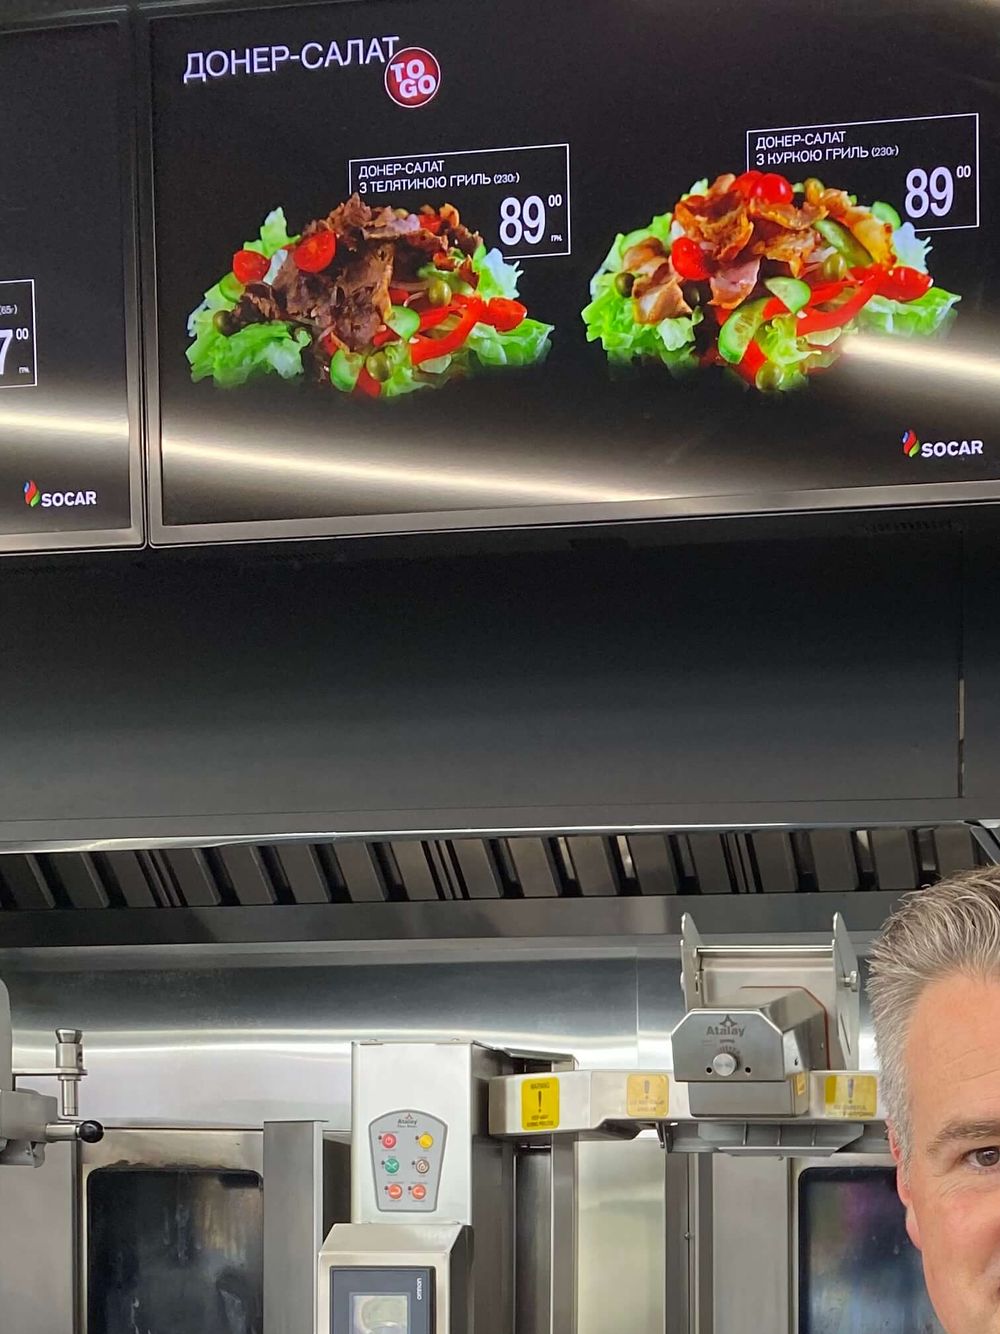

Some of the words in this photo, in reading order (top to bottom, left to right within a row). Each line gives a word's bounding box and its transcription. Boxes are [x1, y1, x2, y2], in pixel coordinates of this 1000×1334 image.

[183, 36, 400, 84] ДОНЕР-САЛАТ
[390, 59, 425, 83] TO
[400, 75, 436, 99] GO
[754, 131, 847, 150] ДОНЕР-САЛАТ
[767, 148, 822, 164] КУРКОЮ
[825, 146, 869, 160] ГРИЛЬ
[358, 160, 444, 179] ДОНЕР-САЛАТ
[956, 165, 971, 178] 00
[370, 176, 447, 193] ТЕЛЯТИНОЮ
[450, 173, 491, 187] ГРИЛЬ
[904, 166, 954, 218] 89
[548, 194, 562, 207] 00
[499, 195, 546, 246] 89
[15, 327, 29, 340] 00
[920, 440, 984, 458] SOCAR
[41, 491, 97, 507] SOCAR
[706, 1025, 746, 1037] Atalay
